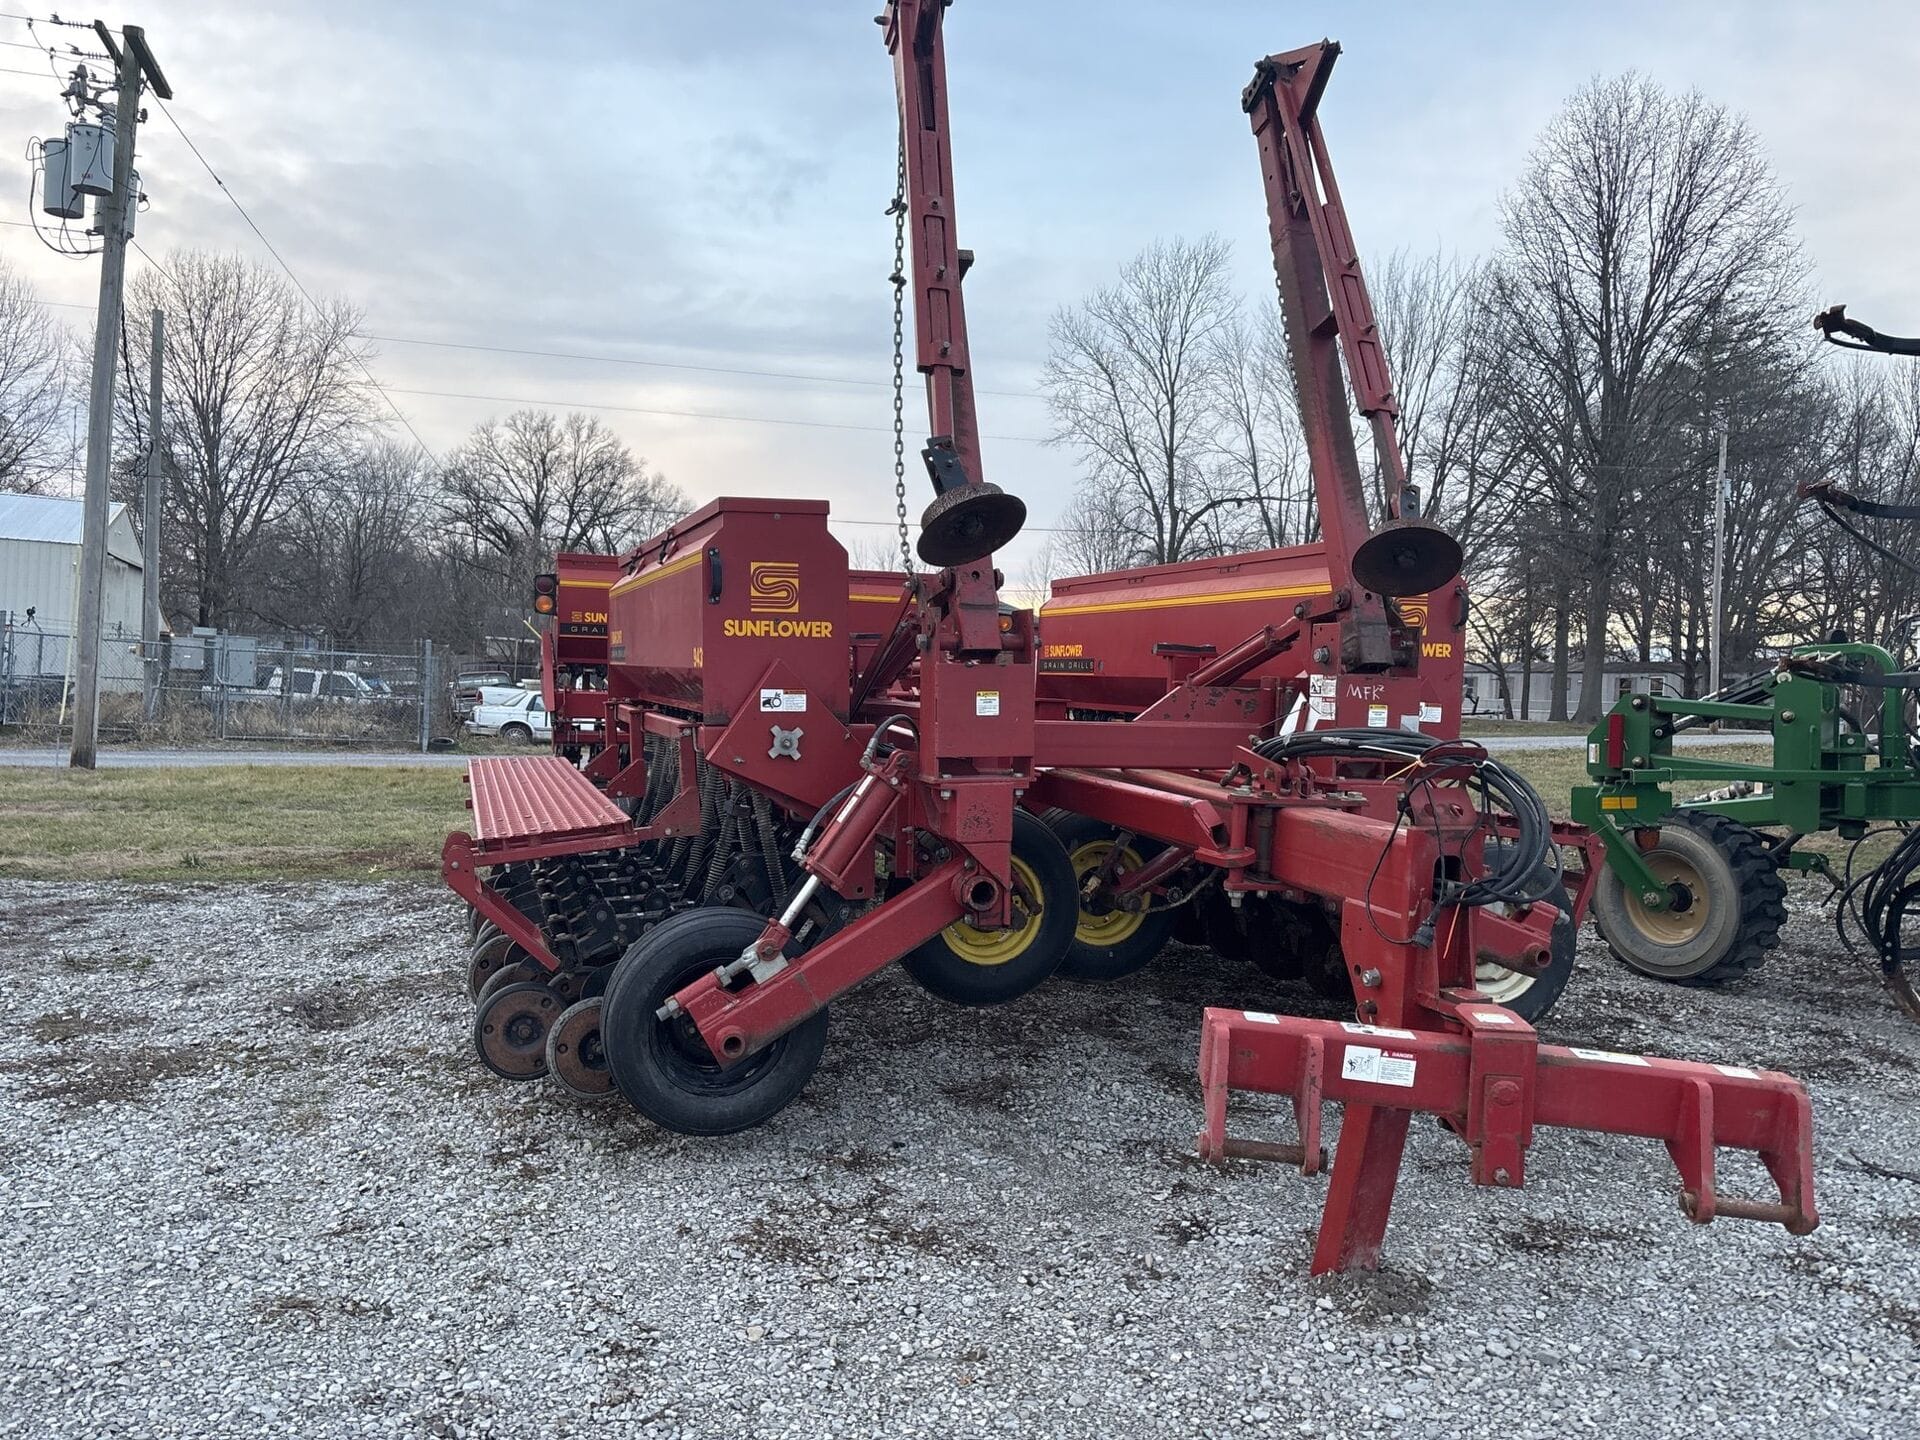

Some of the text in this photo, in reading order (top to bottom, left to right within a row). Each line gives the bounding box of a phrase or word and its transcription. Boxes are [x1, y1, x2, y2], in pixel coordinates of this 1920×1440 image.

[723, 619, 833, 638] SUNFLOWER
[1049, 644, 1083, 658] SUNFLOWER
[1421, 642, 1452, 658] WER
[1043, 661, 1065, 669] GRAIN
